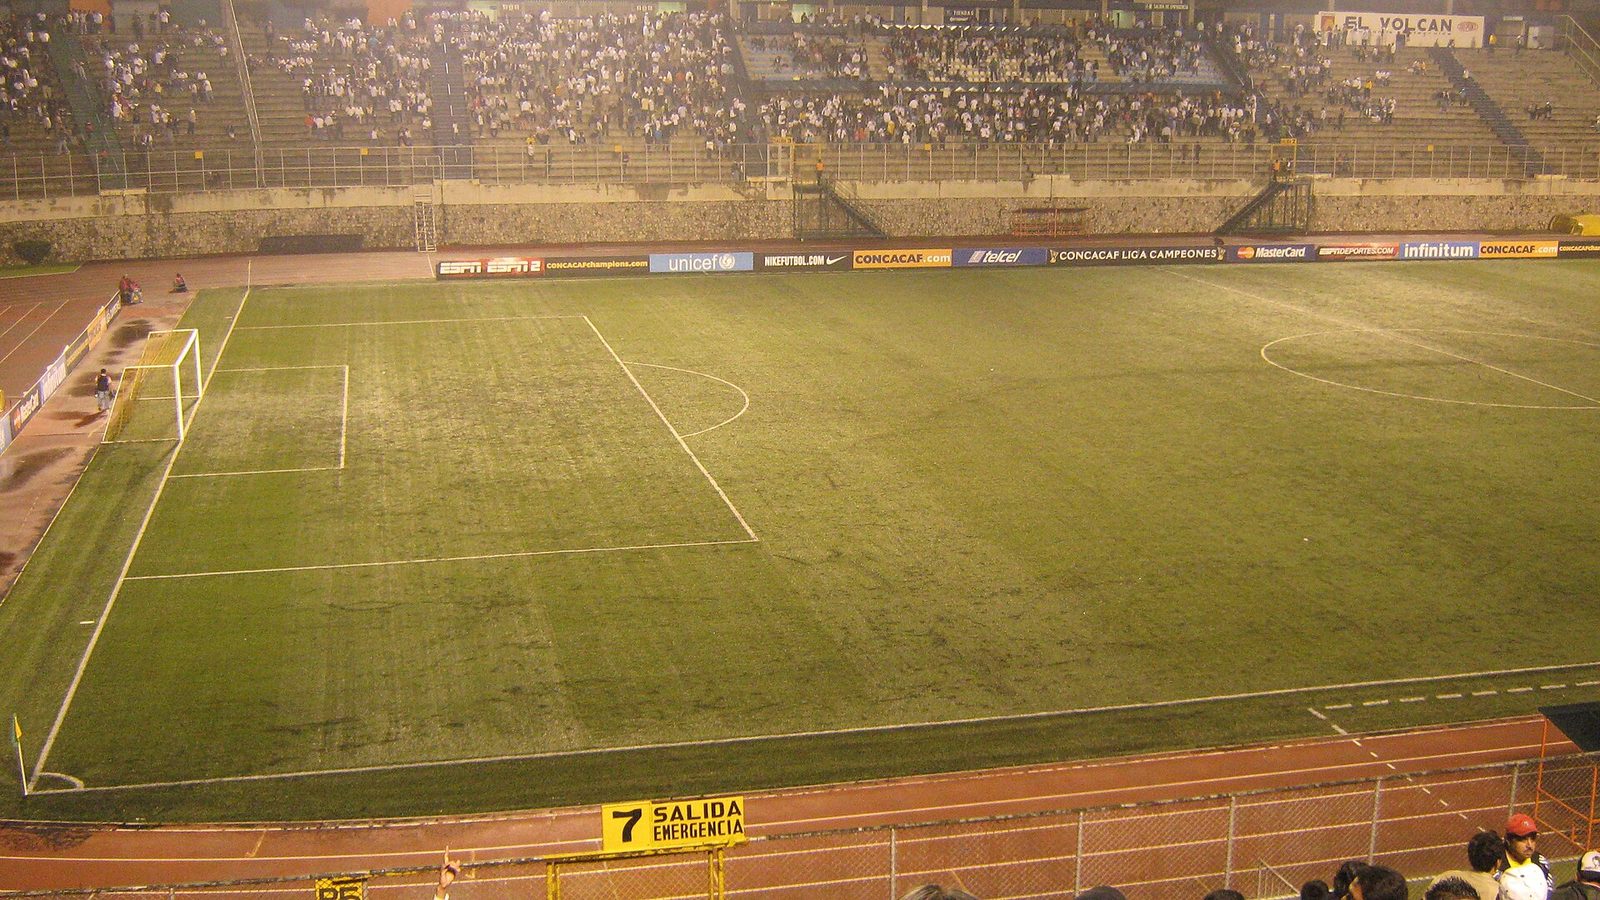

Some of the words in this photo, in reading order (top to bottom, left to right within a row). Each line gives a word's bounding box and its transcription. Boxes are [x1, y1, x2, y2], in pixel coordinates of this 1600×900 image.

[1344, 16, 1369, 30] EL
[1380, 17, 1452, 32] VOLCAN
[983, 249, 1022, 263] telcel
[1059, 250, 1119, 261] CONCACAF
[1121, 250, 1146, 260] LIGA
[1150, 249, 1217, 259] CAMPEONES
[1255, 247, 1305, 259] MasterCard
[1405, 243, 1474, 257] infinitum
[1480, 244, 1557, 255] CONCACAF.com
[546, 259, 649, 270] CONCACAFchampions.com
[668, 254, 718, 270] unicef
[764, 255, 825, 266] NIKEFUTBOL.COM
[855, 252, 951, 265] CONCACAF.com
[440, 261, 482, 274] ESPN
[486, 261, 528, 273] ESPN
[653, 800, 742, 823] SALIDA
[612, 808, 642, 843] 7
[653, 819, 744, 842] EMERGENCIA
